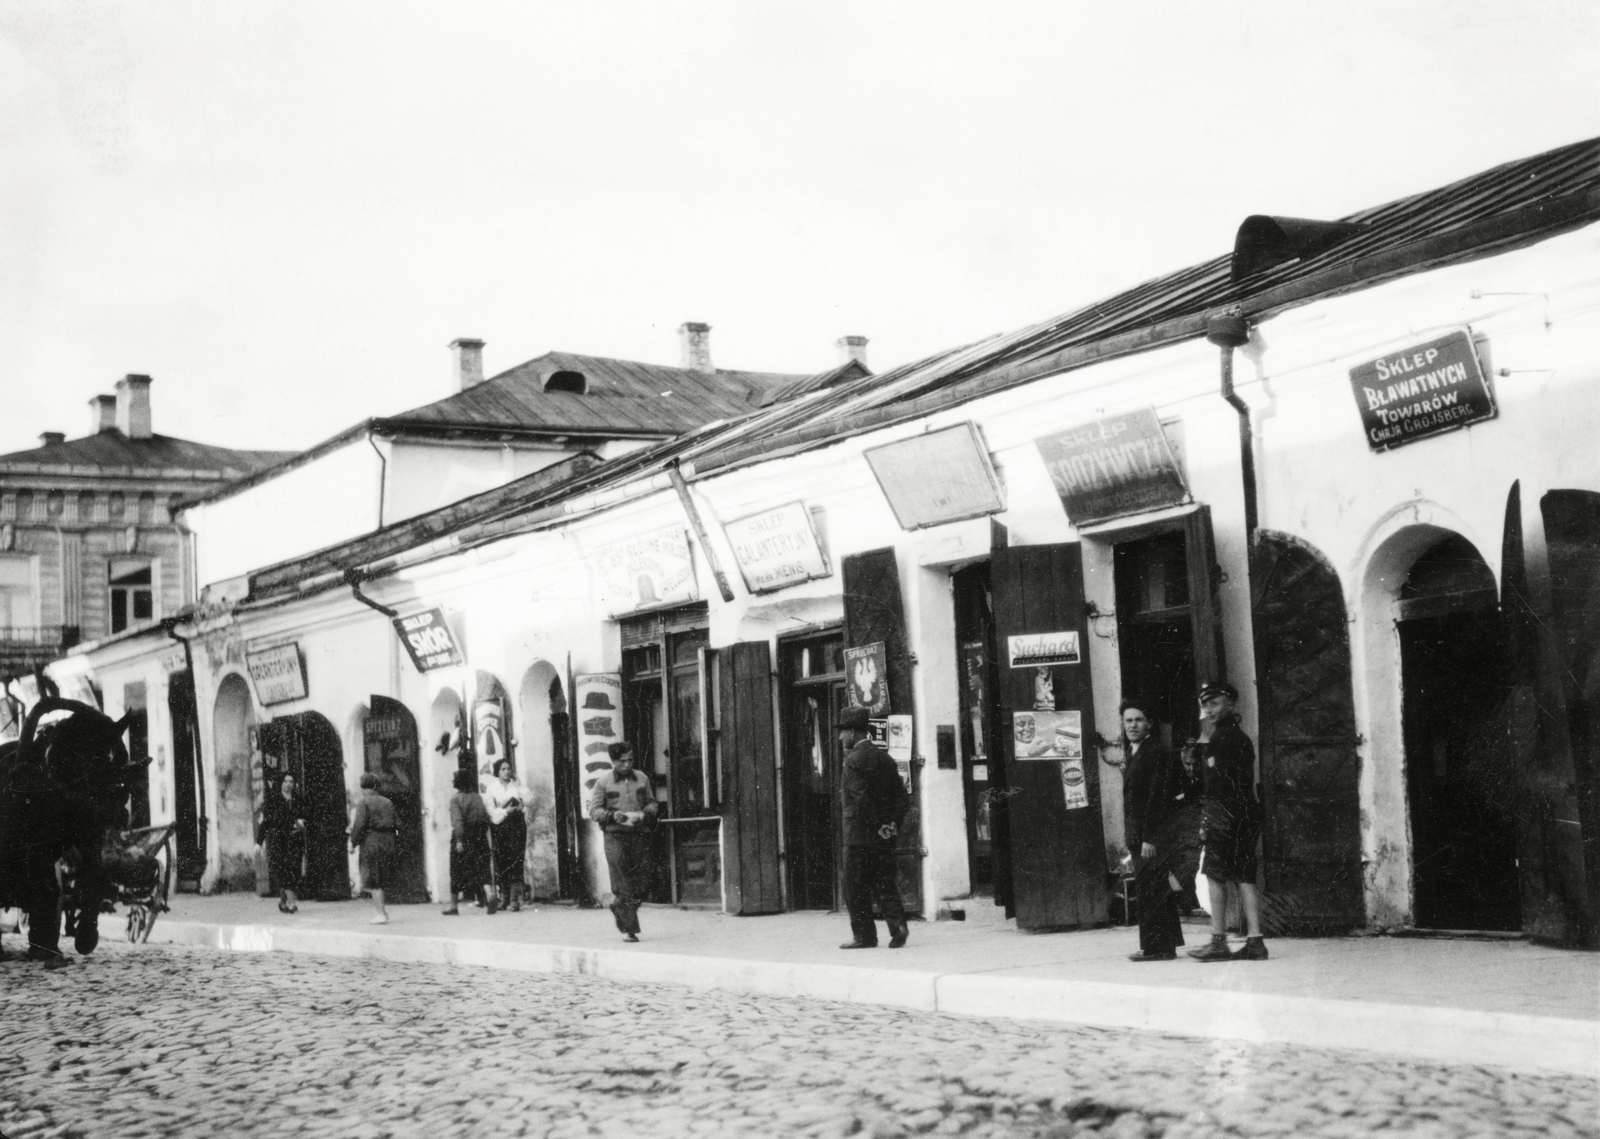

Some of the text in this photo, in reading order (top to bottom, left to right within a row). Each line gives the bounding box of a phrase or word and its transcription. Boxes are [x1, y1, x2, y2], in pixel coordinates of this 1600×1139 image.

[1375, 348, 1438, 381] SKLEP
[1363, 362, 1467, 410] BŁAWATNYCH
[1376, 391, 1458, 425] TOWARÓW
[1059, 421, 1127, 450] SKLEP
[748, 512, 784, 535] SKLEP
[736, 528, 811, 566] GALANTERYJNY
[1011, 633, 1078, 656] Suchard
